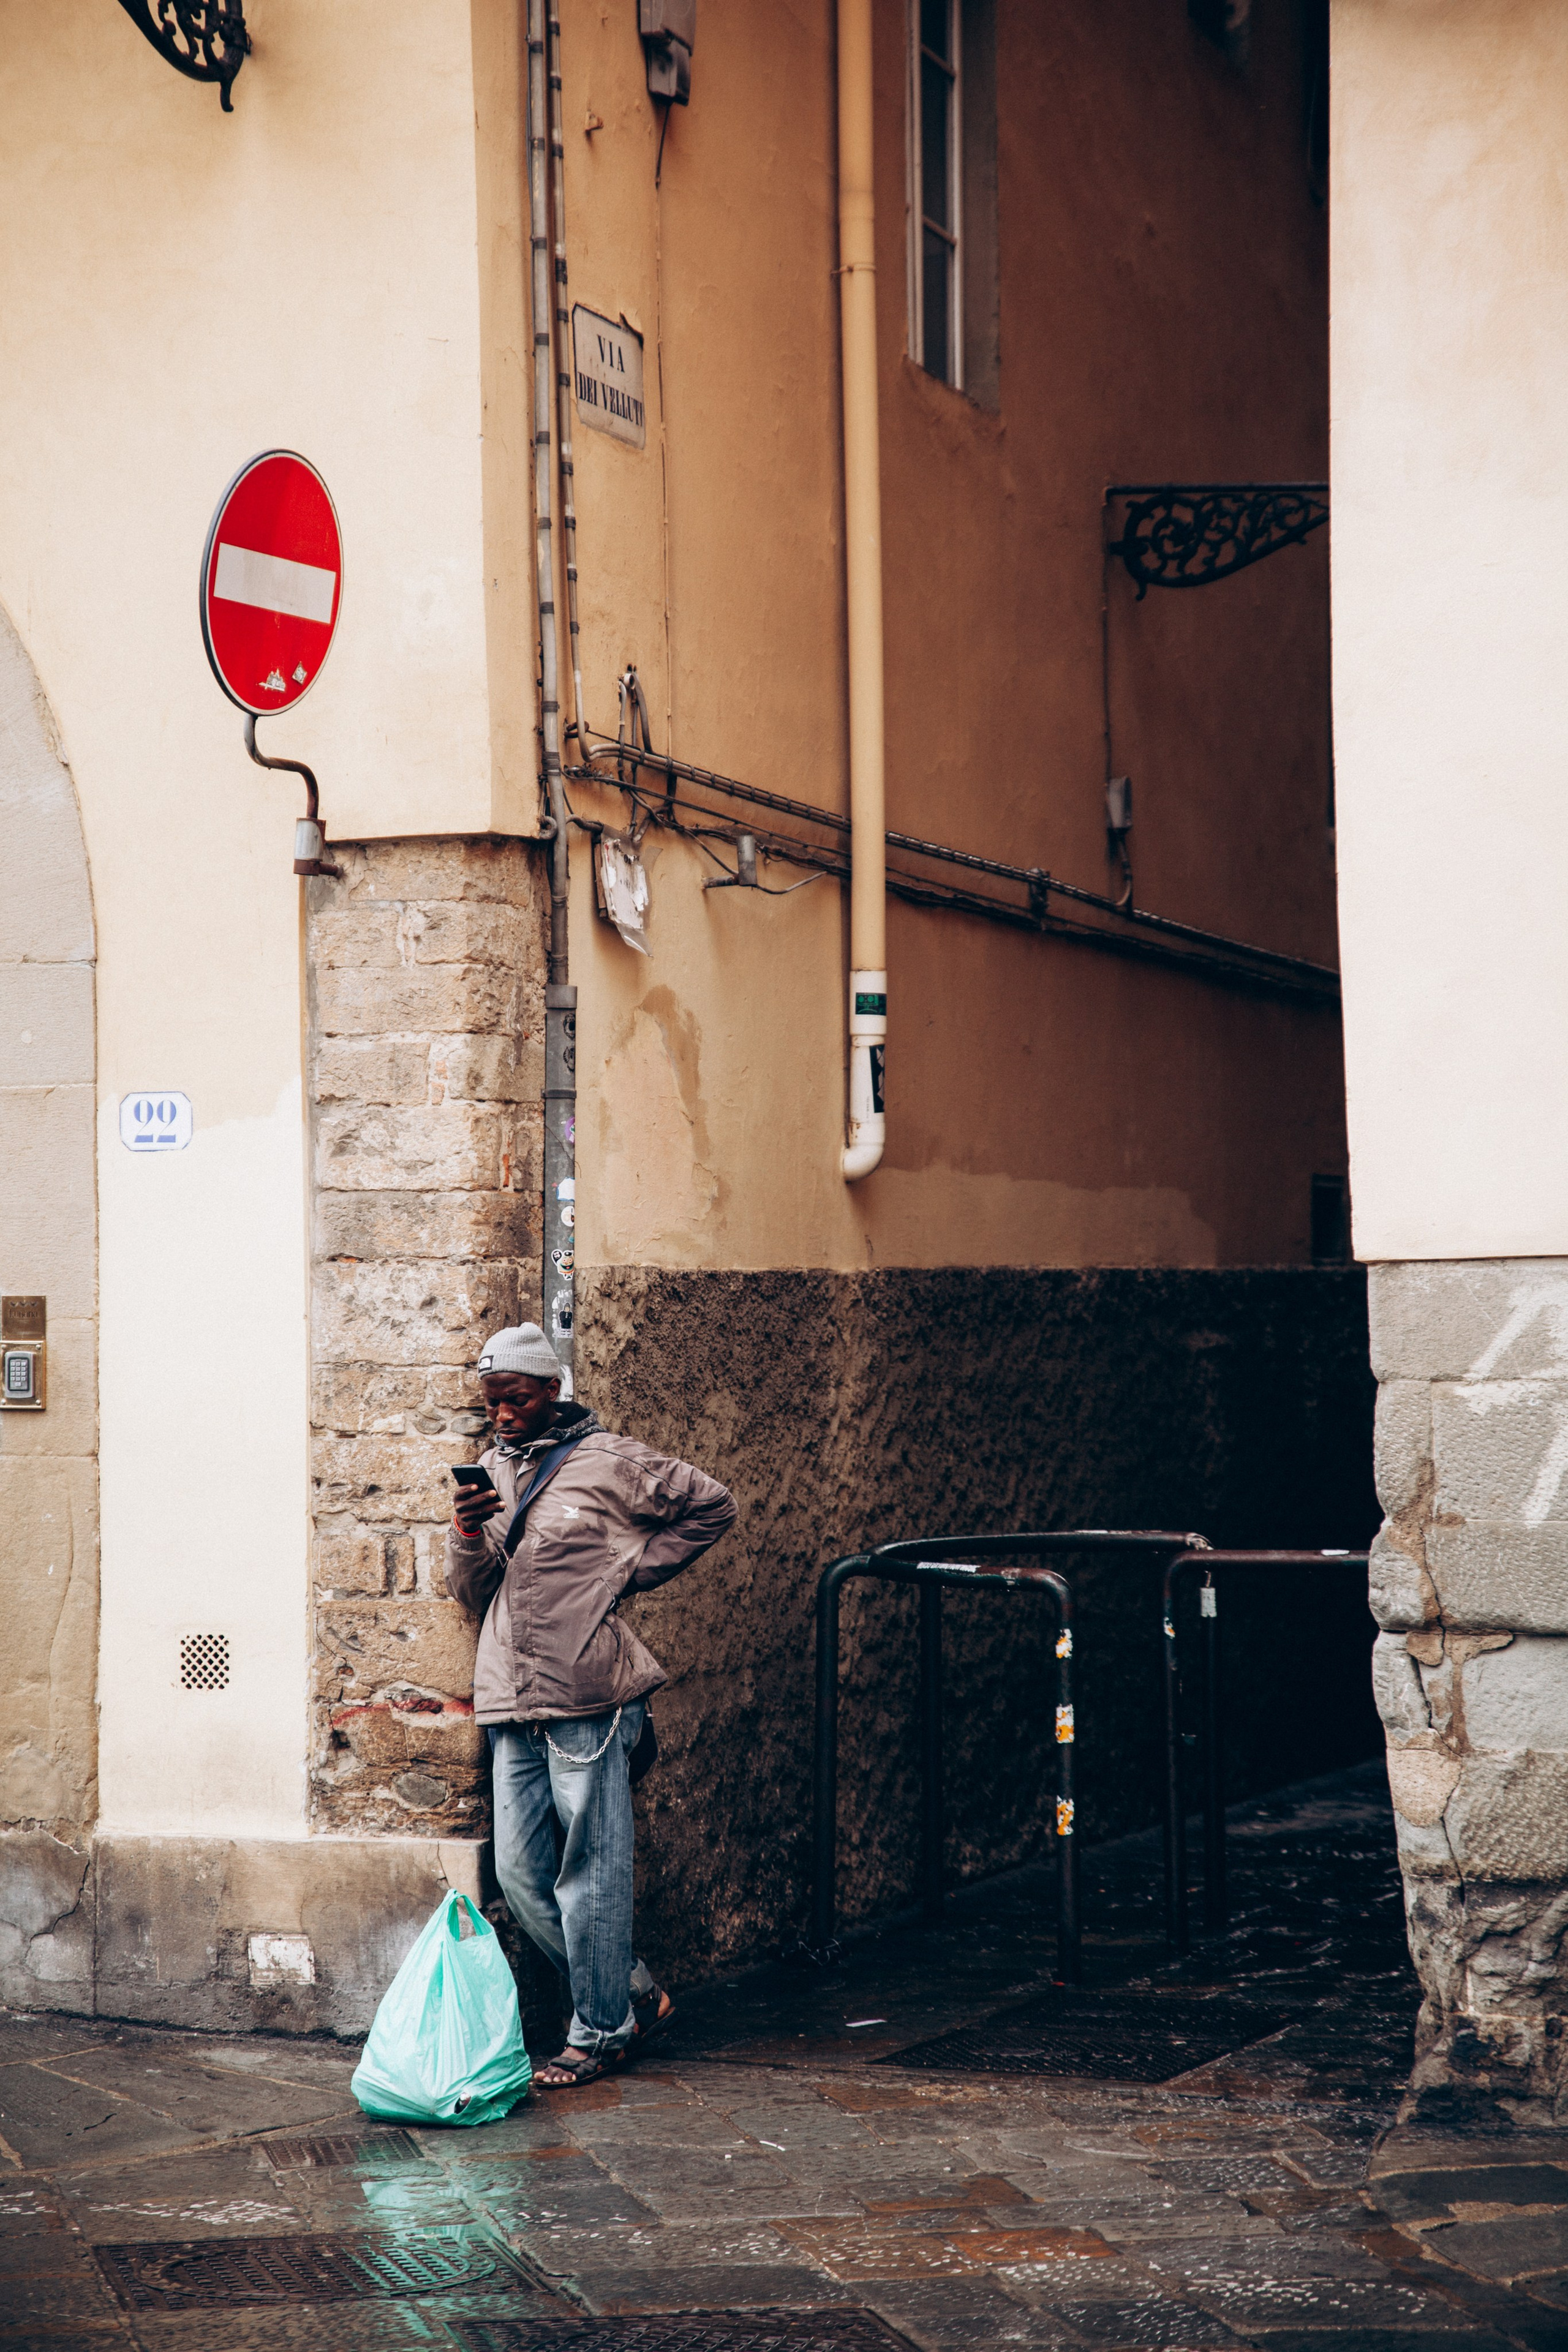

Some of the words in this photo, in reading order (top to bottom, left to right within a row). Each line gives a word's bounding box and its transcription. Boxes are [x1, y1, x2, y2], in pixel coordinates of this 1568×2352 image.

[597, 334, 625, 373] VIA
[578, 372, 598, 406] DEI
[601, 382, 643, 428] VELLUTI
[134, 1099, 176, 1143] 22
